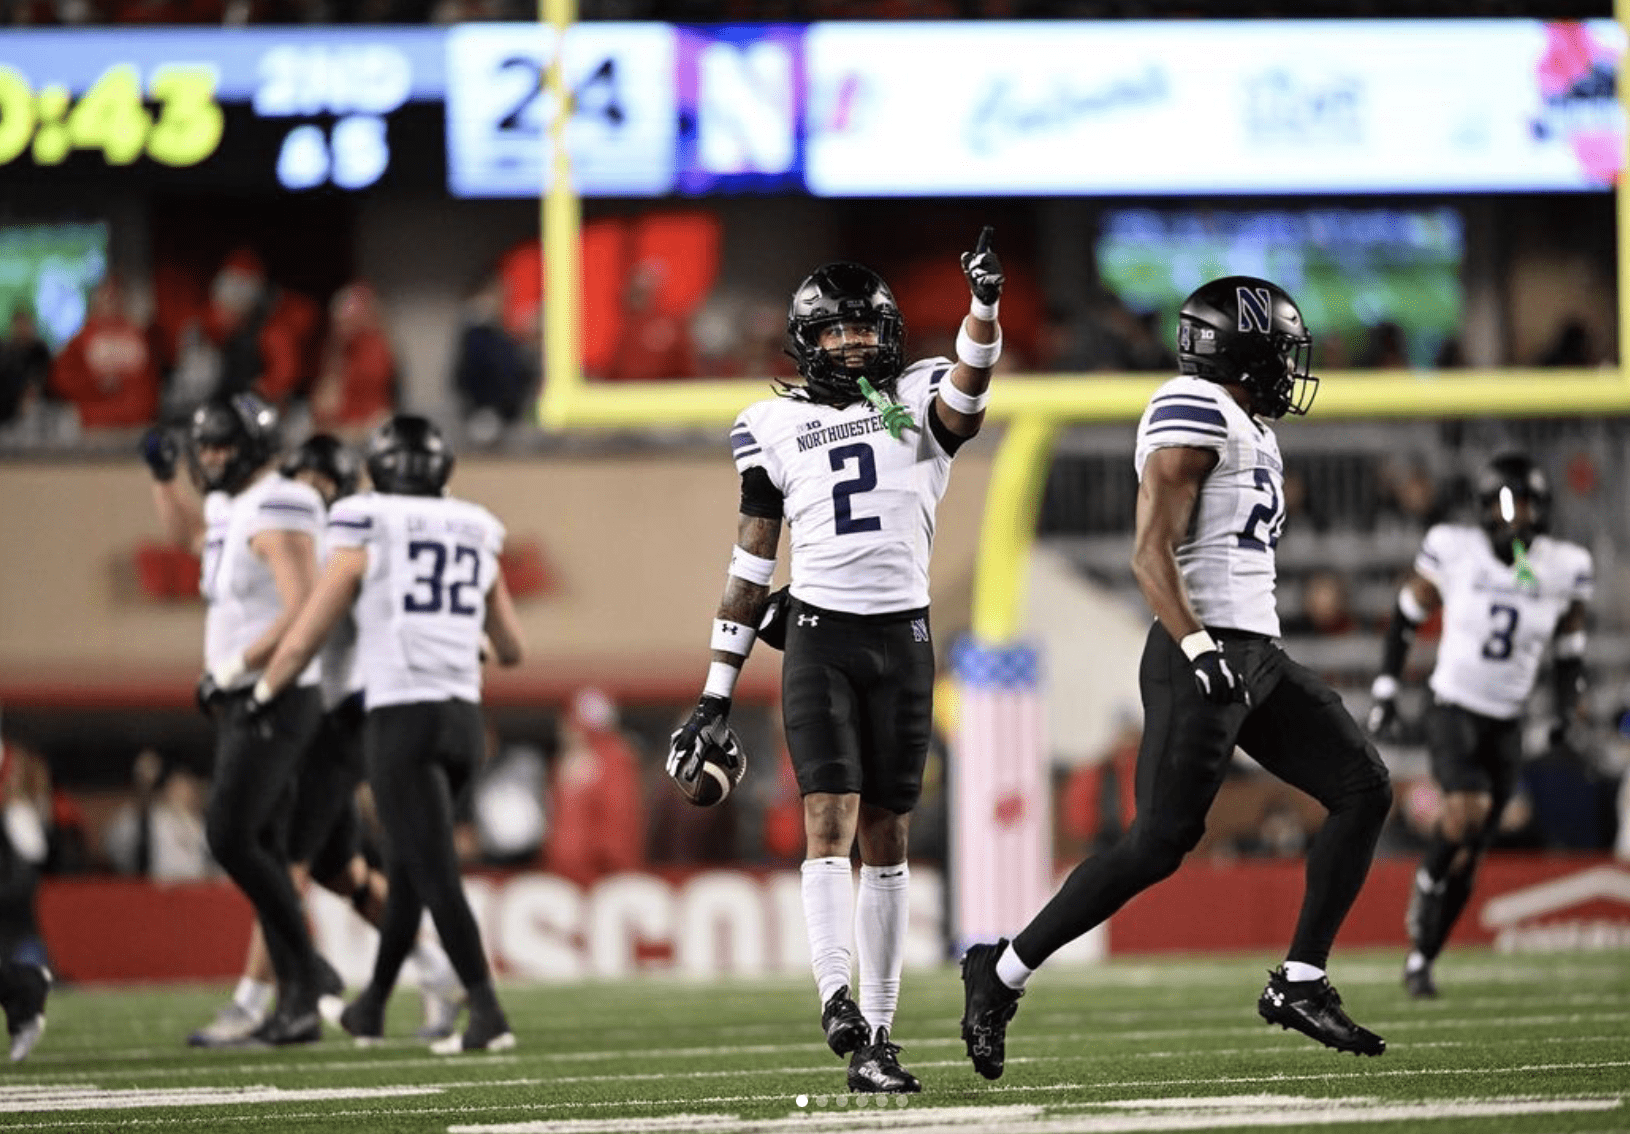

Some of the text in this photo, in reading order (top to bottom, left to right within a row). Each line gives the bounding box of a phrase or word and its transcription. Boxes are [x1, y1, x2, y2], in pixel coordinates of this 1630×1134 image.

[497, 56, 626, 134] 24
[1236, 286, 1272, 333] N
[796, 414, 889, 452] NORTHWESTER
[828, 442, 881, 536] 2
[403, 540, 480, 616] 32
[1482, 604, 1519, 661] 3
